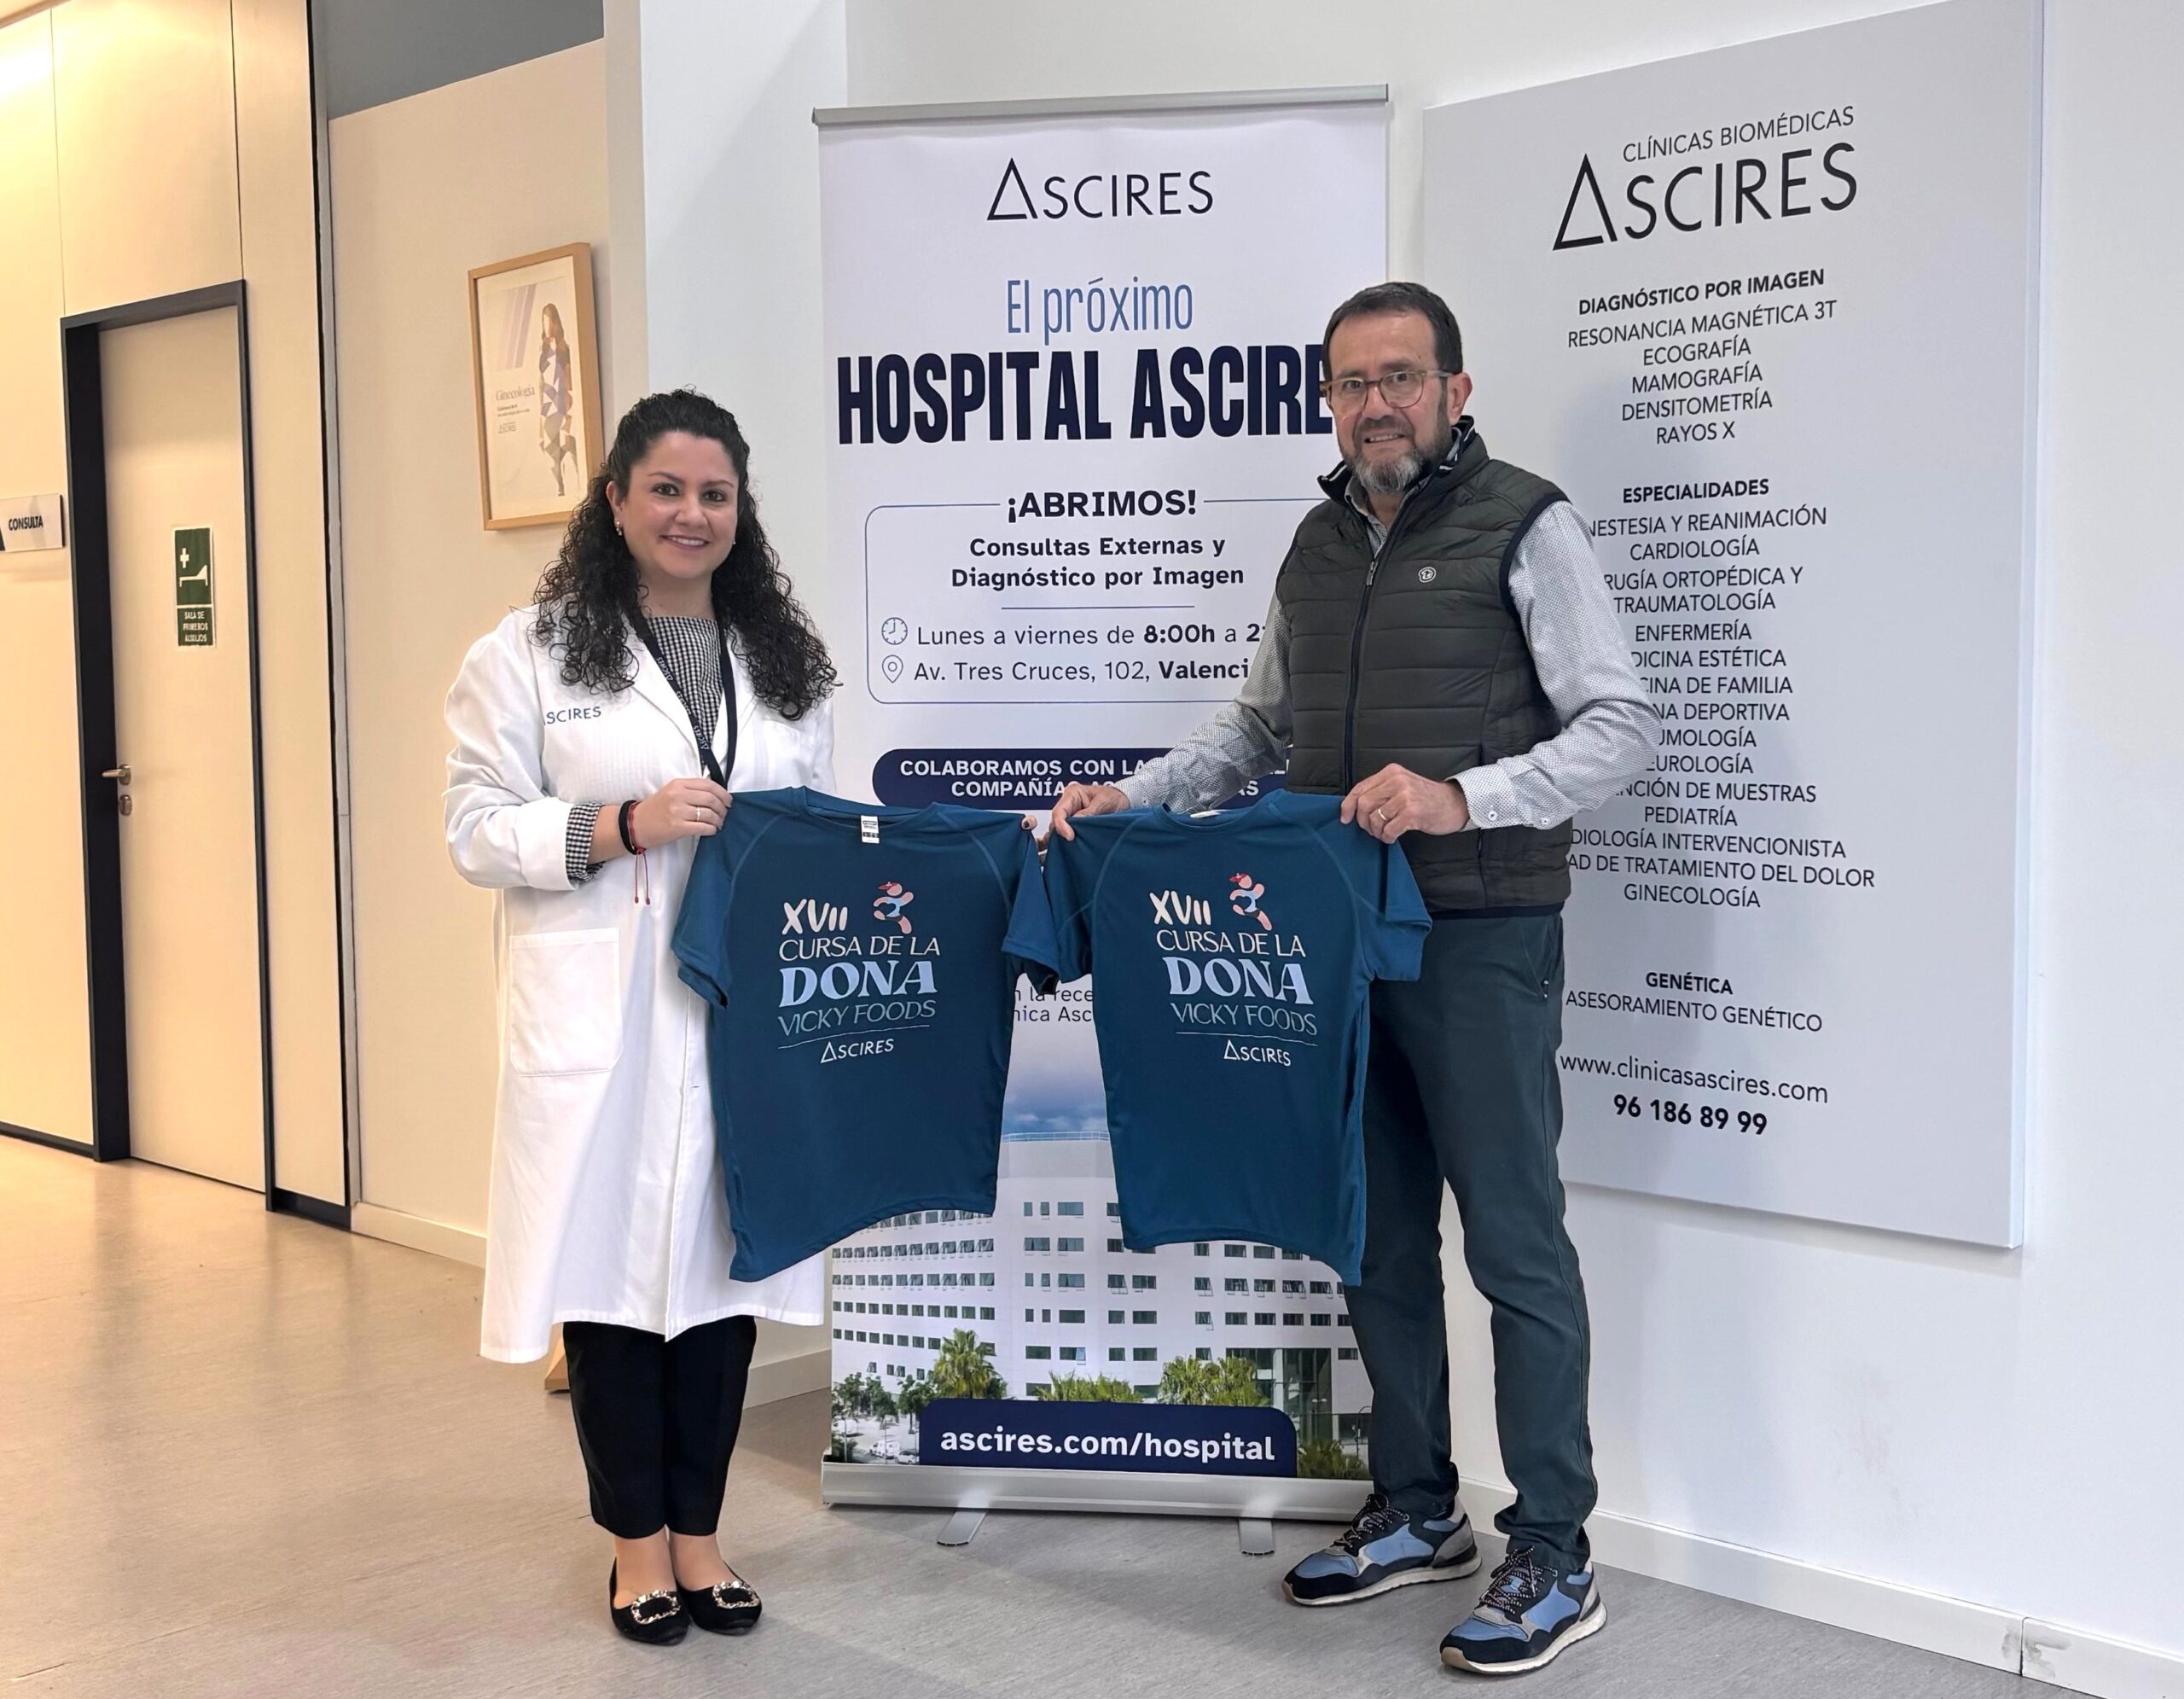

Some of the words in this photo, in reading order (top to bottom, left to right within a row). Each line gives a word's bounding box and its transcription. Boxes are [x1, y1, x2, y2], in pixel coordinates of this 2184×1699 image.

[1623, 130, 1713, 162] CLÍNICAS
[1720, 106, 1855, 146] BIOMÉDICAS
[986, 157, 1214, 221] ASCIRES
[1552, 142, 1857, 251] ASCIRES
[1578, 287, 1699, 316] DIAGNÓSTICO
[1705, 280, 1741, 300] POR
[1747, 268, 1825, 294] IMAGEN
[1008, 279, 1030, 333] El
[1043, 276, 1194, 346] próximo
[1568, 318, 1686, 348] RESONANCIA
[1691, 304, 1808, 334] MAGNÉTICA
[1814, 300, 1837, 320] 3T
[1643, 335, 1751, 366] ECOGRAFÍA
[1631, 361, 1763, 393] MAMOGRAFÍA
[837, 351, 1112, 444] HOSPITAL
[1130, 344, 1333, 438] ASCIRE
[1622, 390, 1773, 421] DENSITOMETRÍA
[1657, 422, 1717, 445] RAYOS
[1722, 422, 1735, 439] X
[1623, 479, 1769, 503] ESPECIALIDADES
[1007, 489, 1197, 523] ¡ABRIMOS!
[9, 515, 44, 531] CONSULTA
[1589, 516, 1666, 537] NESTESIA
[1671, 515, 1682, 532] Y
[1688, 504, 1827, 532] REANIMACIÓN
[970, 538, 1090, 557] Consultas
[1099, 537, 1203, 556] Externas
[1212, 538, 1226, 557] y
[1630, 534, 1760, 561] CARDIOLOGÍA
[951, 566, 1095, 591] Diagnóstico
[1105, 567, 1143, 590] por
[1152, 567, 1244, 589] Imagen
[1604, 568, 1658, 591] RUGÍA
[1663, 565, 1785, 589] ORTOPÉDICA
[1791, 567, 1803, 585] Y
[1614, 589, 1775, 614] TRAUMATOLOGÍA
[917, 625, 985, 645] Lunes
[994, 631, 1006, 645] a
[1014, 625, 1098, 644] viernes
[1107, 624, 1135, 644] de
[1143, 624, 1215, 643] 8:00h
[1225, 628, 1236, 643] a
[1246, 624, 1265, 642] 2
[1635, 619, 1751, 642] ENFERMERÍA
[914, 663, 946, 681] Av.
[955, 662, 1003, 680] Tres
[1012, 660, 1096, 682] Cruces,
[1104, 661, 1151, 682] 102,
[1158, 658, 1248, 679] Valenci
[1631, 650, 1693, 667] DICINA
[1699, 647, 1786, 667] ESTÉTICA
[1687, 677, 1711, 694] DE
[1717, 676, 1792, 694] FAMILIA
[546, 707, 601, 724] SCIRES
[1684, 703, 1790, 720] DEPORTIVA
[900, 759, 1062, 777] COLABORAMOS
[1070, 759, 1114, 776] CON
[1122, 759, 1144, 775] LA
[1647, 753, 1753, 774] UROLOGÍA
[951, 775, 1068, 797] COMPAÑÍA
[1686, 782, 1711, 800] DE
[1716, 782, 1816, 803] MUESTRAS
[1644, 805, 1738, 826] PEDIATRÍA
[1571, 828, 1657, 848] DIOLOGÍA
[1662, 833, 1846, 858] INTERVENCIONISTA
[1568, 853, 1591, 870] AD
[1596, 855, 1619, 872] DE
[1624, 856, 1756, 881] TRATAMIENTO
[1761, 864, 1798, 884] DEL
[1804, 866, 1875, 888] DOLOR
[1148, 889, 1211, 926] XVII
[1623, 883, 1761, 908] GINECOLOGÍA
[781, 899, 848, 935] XVII
[778, 936, 862, 962] CURSA
[869, 935, 904, 956] DE
[909, 937, 940, 957] LA
[1156, 929, 1234, 953] CURSA
[1238, 933, 1269, 955] DE
[1275, 934, 1306, 957] LA
[778, 960, 938, 1008] DONA
[1162, 956, 1315, 1005] DONA
[1646, 971, 1734, 995] GENÉTICA
[1054, 990, 1093, 1002] rece
[778, 1005, 850, 1036] VICKY
[853, 1000, 937, 1024] FOODS
[1014, 1005, 1050, 1021] nica
[1058, 1006, 1092, 1021] Asc
[1170, 1002, 1242, 1026] VICKY
[1244, 1004, 1317, 1036] FOODS
[1565, 990, 1717, 1021] ASESORAMIENTO
[1722, 1004, 1823, 1032] GENÉTICO
[820, 1039, 894, 1064] ASCIRES
[1223, 1039, 1292, 1067] ASCIRES
[1560, 1054, 1829, 1103] www.clinicasascires.com
[1613, 1094, 1641, 1117] 96
[1650, 1099, 1692, 1125] 186
[1699, 1106, 1729, 1131] 89
[1737, 1111, 1768, 1135] 99
[940, 1424, 1275, 1463] ascires.com/hospital
